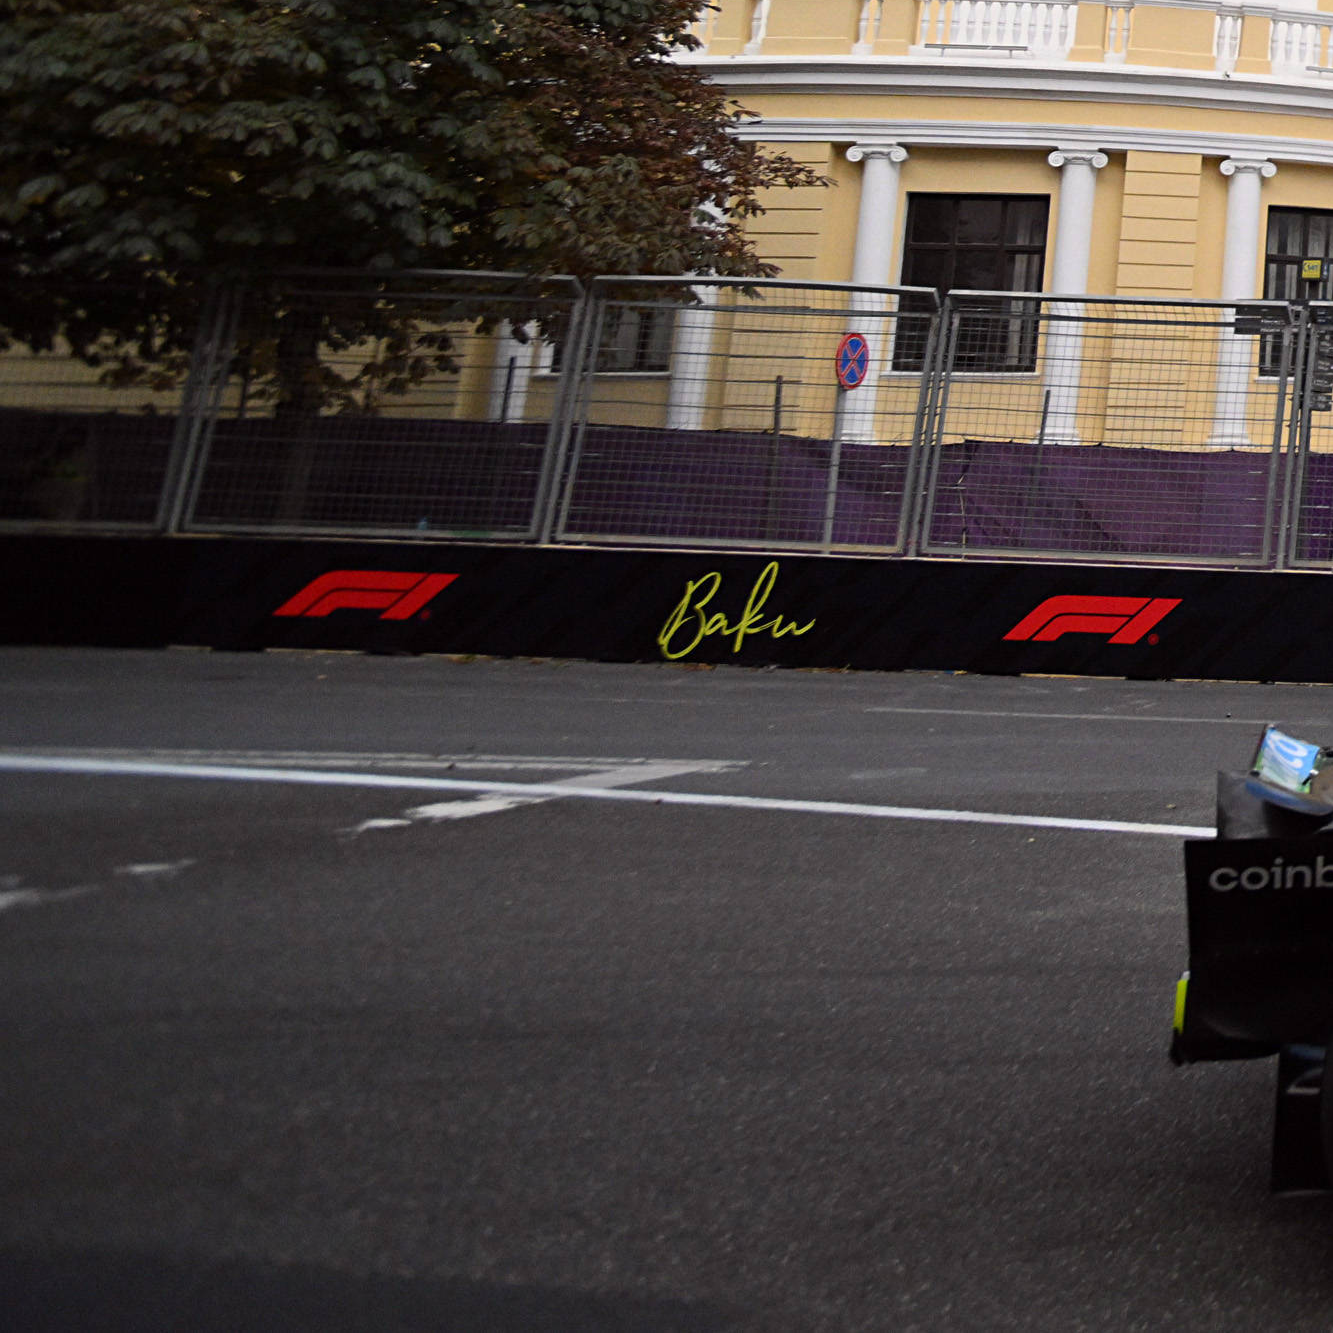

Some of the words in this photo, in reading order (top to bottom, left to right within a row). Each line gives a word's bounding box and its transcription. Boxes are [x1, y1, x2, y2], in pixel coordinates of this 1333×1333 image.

[274, 570, 460, 620] F1
[657, 560, 816, 660] Baku
[1002, 594, 1183, 644] F1
